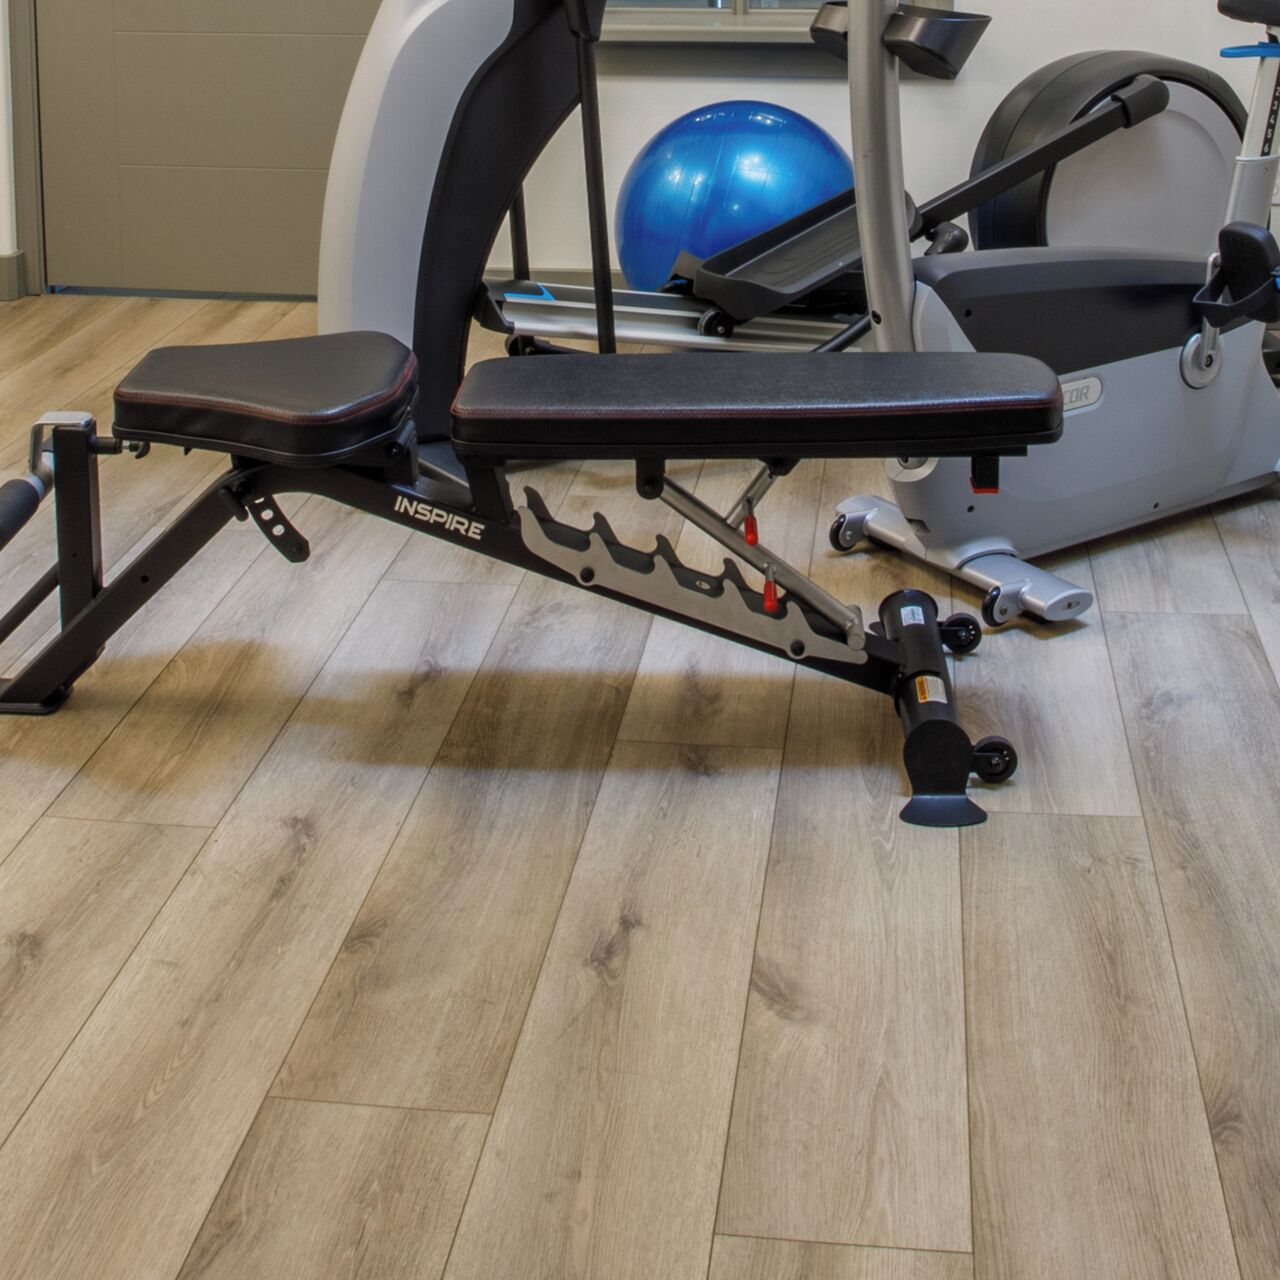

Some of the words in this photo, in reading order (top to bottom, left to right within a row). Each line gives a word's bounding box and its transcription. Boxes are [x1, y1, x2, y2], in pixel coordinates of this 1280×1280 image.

[1275, 87, 1280, 96] 2
[1272, 101, 1278, 110] 3
[1269, 115, 1275, 124] 4
[1267, 129, 1273, 138] 5
[1263, 143, 1269, 152] 6
[393, 495, 486, 540] INSPIRE
